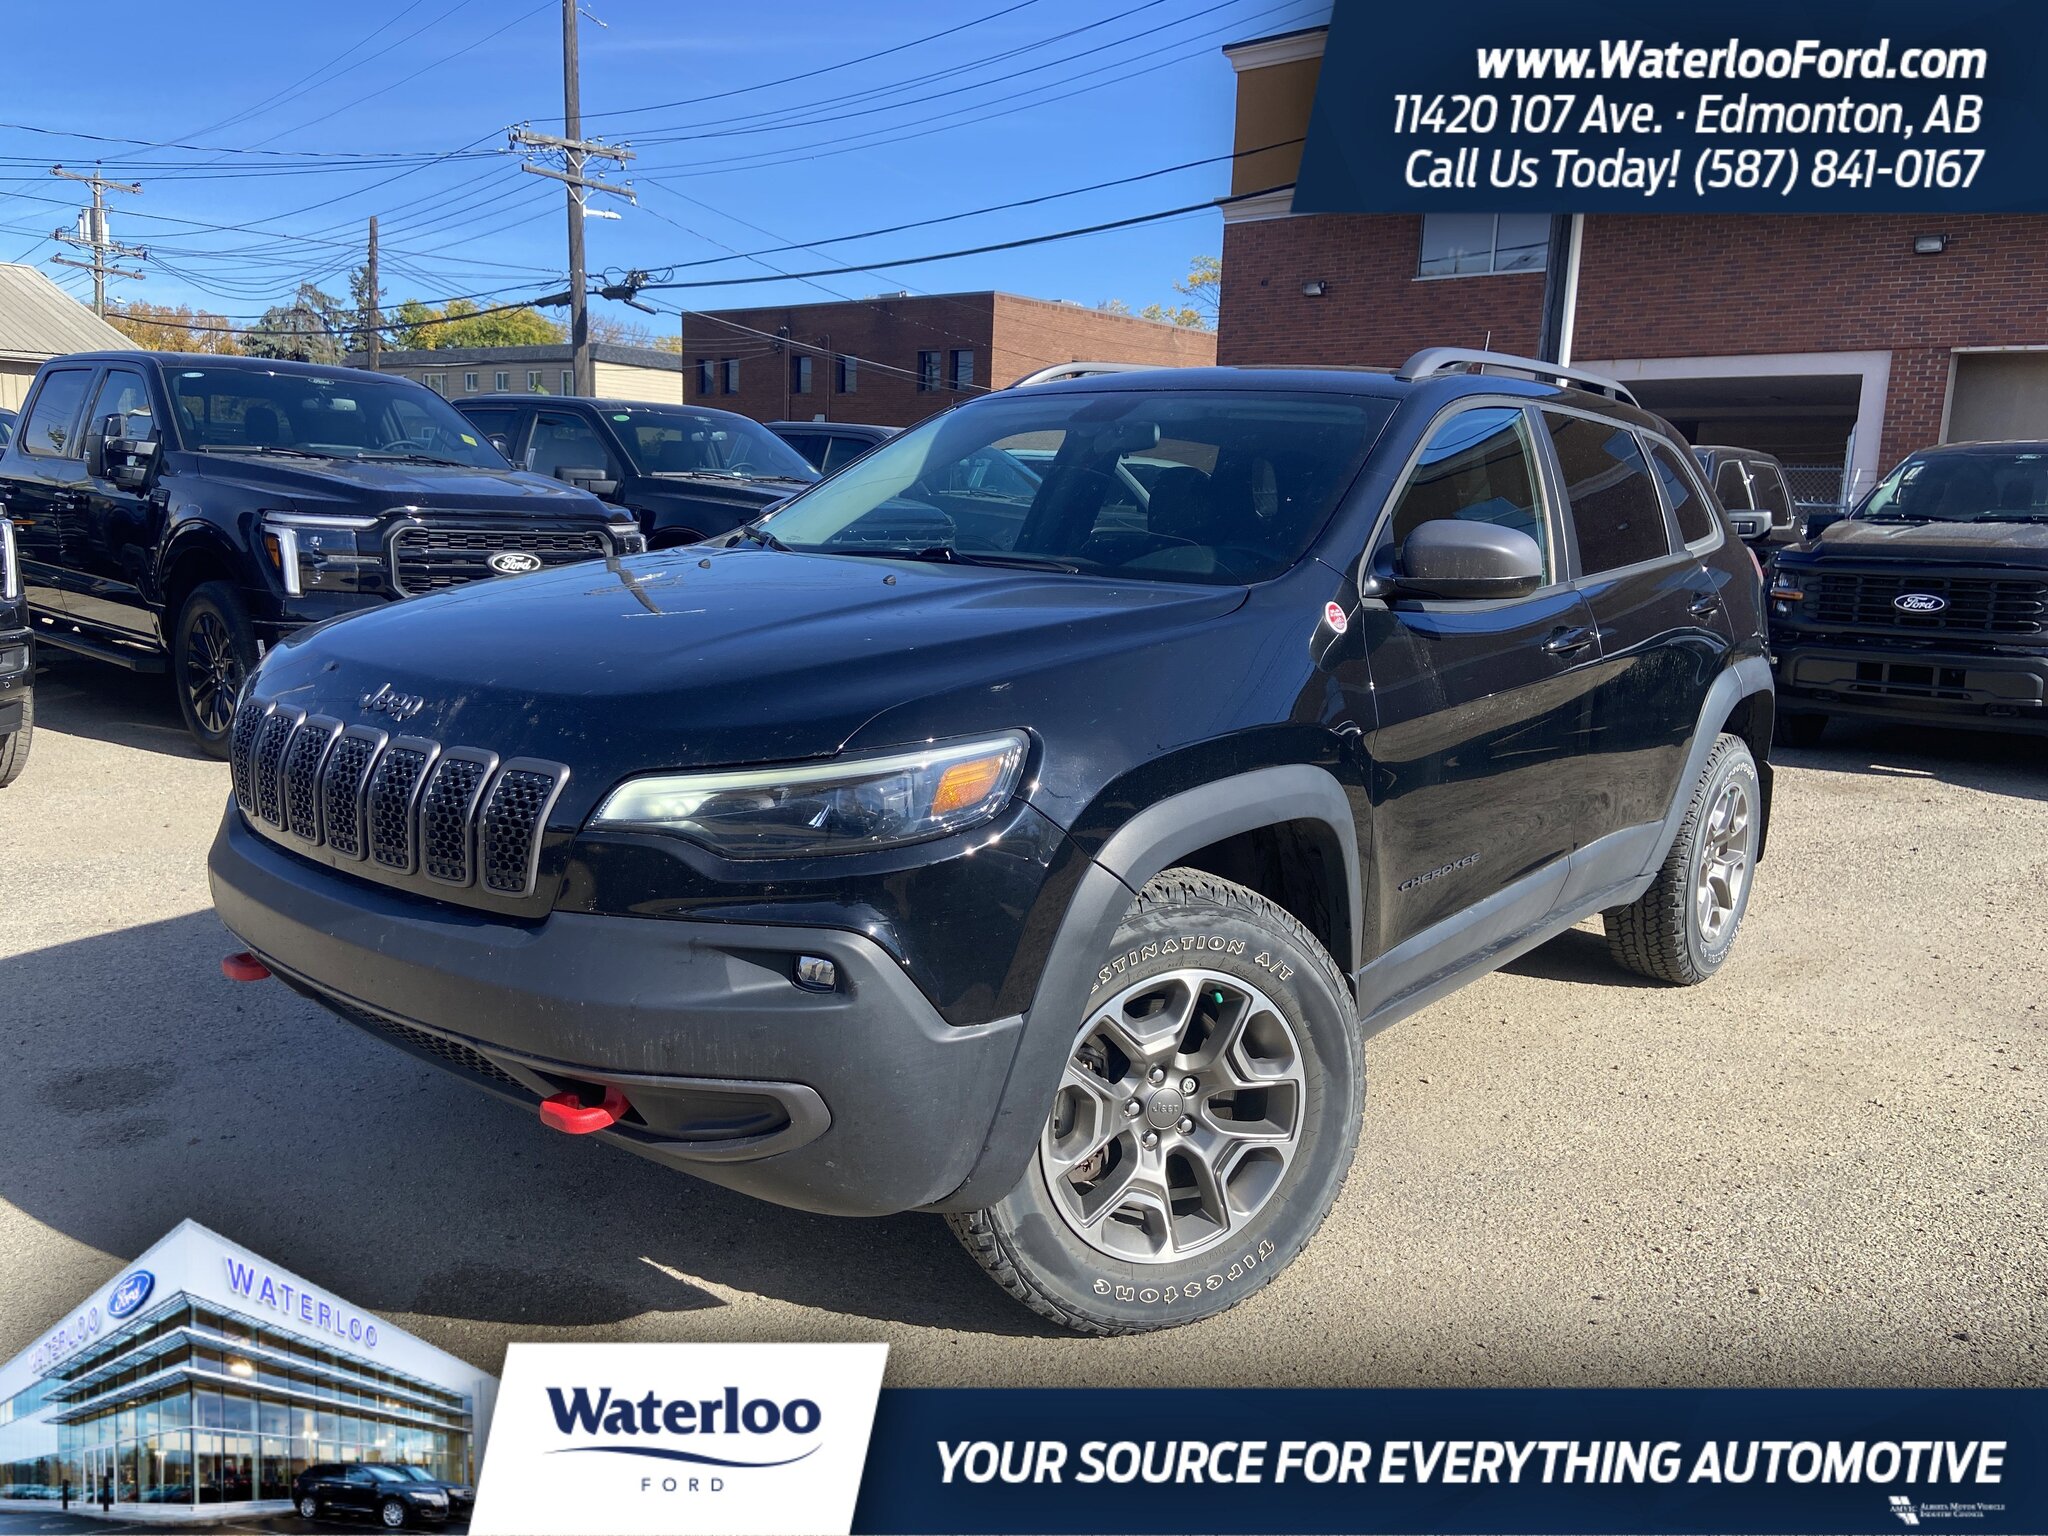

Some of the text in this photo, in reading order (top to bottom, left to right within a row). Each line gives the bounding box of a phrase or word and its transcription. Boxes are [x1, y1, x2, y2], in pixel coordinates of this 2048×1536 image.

[501, 556, 532, 570] Ford
[1903, 596, 1936, 609] Ford
[359, 682, 424, 722] Jeep
[1397, 851, 1481, 892] CHEROKEE
[1090, 935, 1295, 995] STINATION A/T
[1093, 1239, 1275, 1304] Firestone
